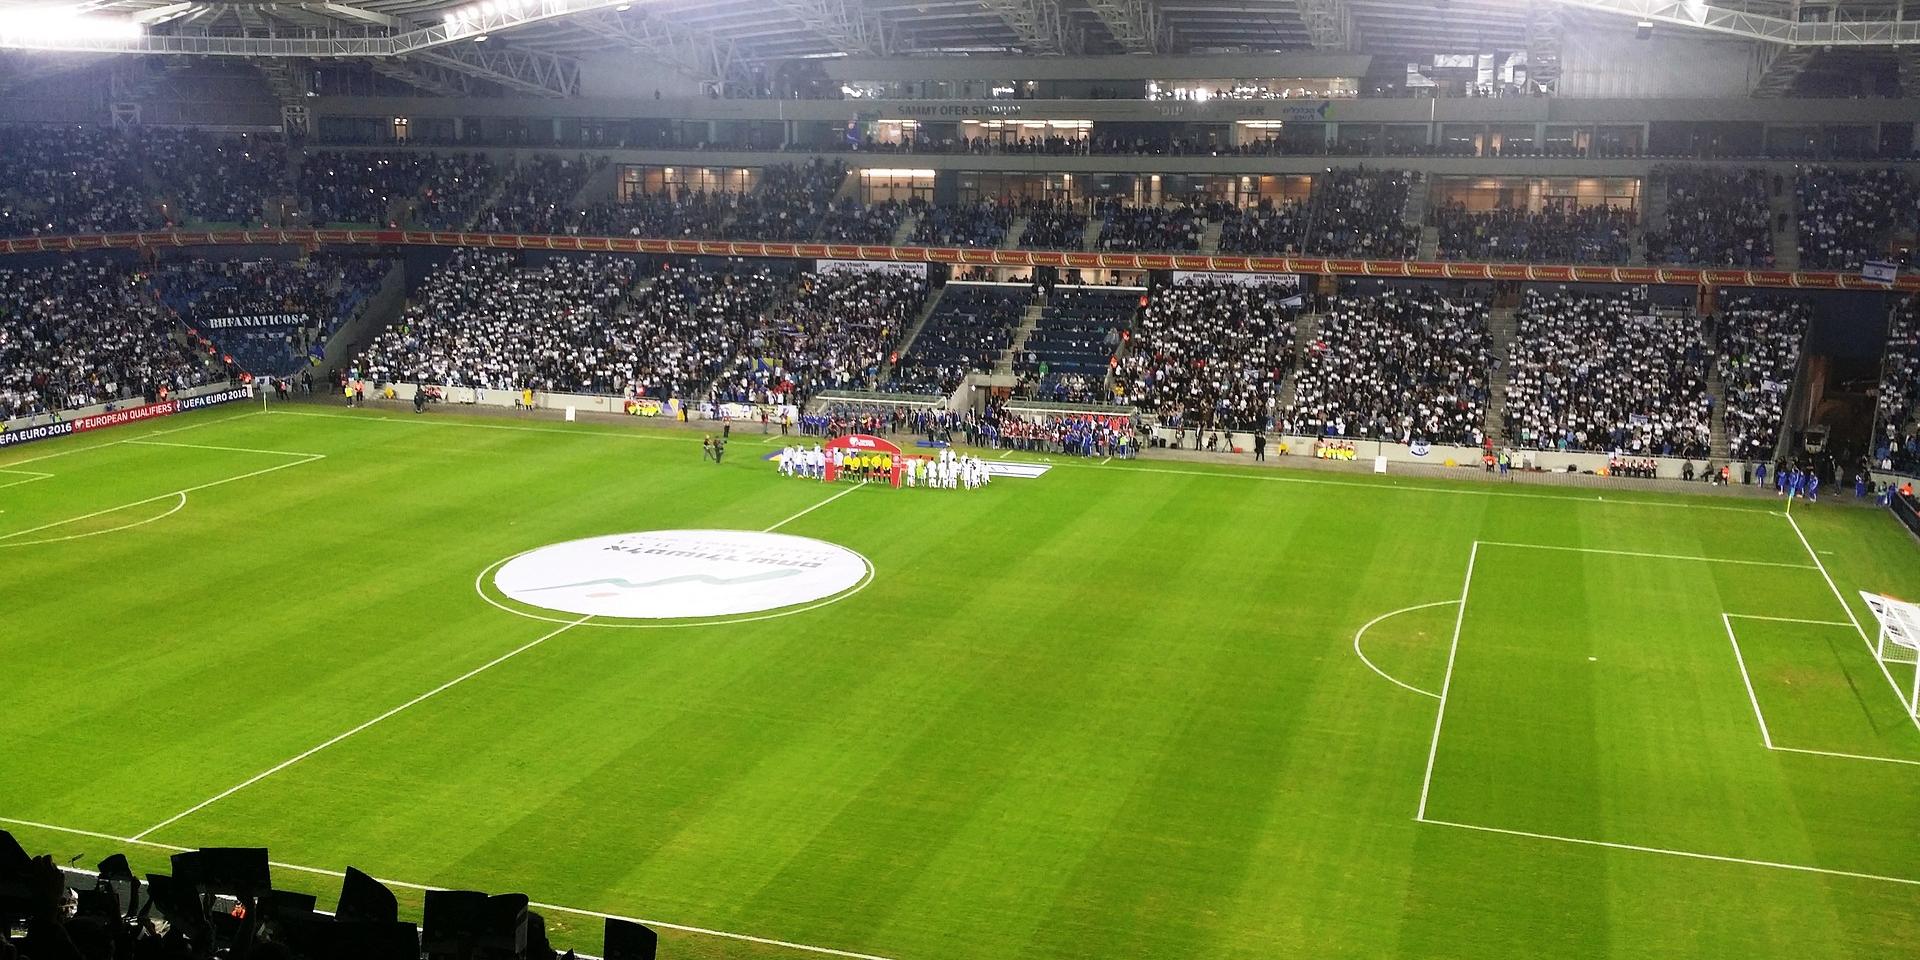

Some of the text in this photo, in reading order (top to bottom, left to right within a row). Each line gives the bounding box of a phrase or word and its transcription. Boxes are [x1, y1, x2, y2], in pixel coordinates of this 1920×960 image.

[898, 105, 1020, 116] SAMMY OFER STADIUM
[183, 388, 247, 409] UEFA EURO 2016
[85, 402, 172, 428] EUROPEAN QUALIFIERS
[0, 422, 72, 445] EFA EURO 2016
